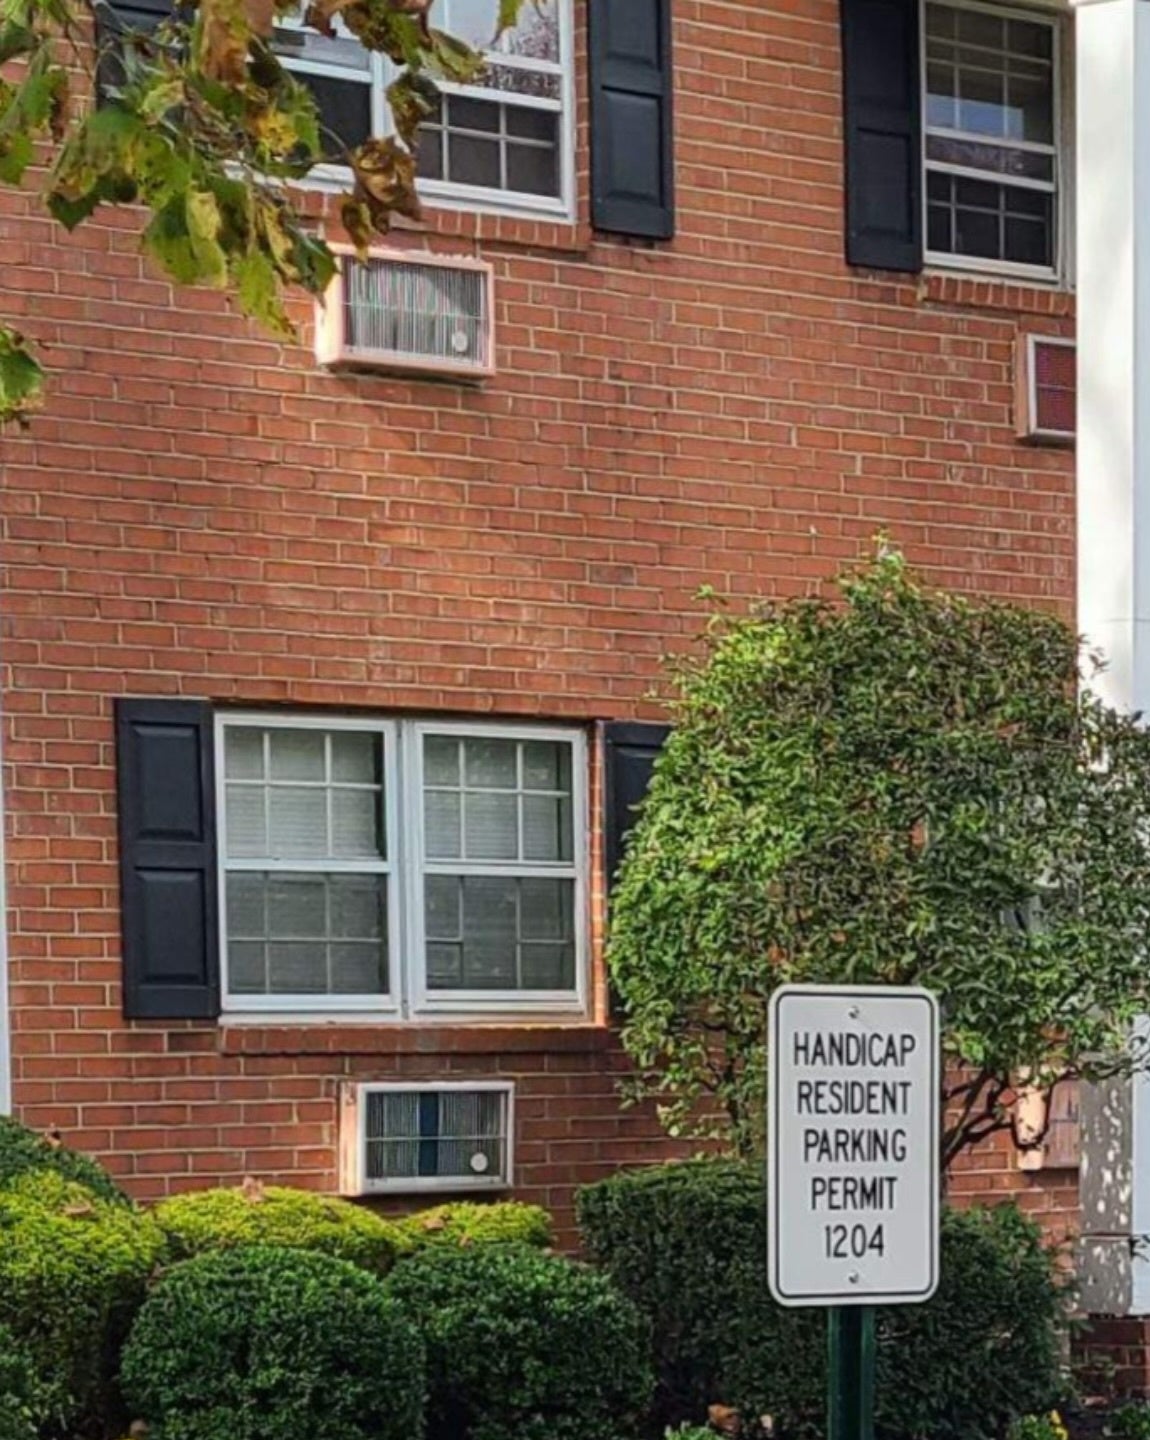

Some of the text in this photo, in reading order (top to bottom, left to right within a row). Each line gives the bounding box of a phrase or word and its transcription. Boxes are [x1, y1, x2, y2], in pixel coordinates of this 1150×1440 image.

[793, 1031, 917, 1067] HANDICAP
[796, 1079, 913, 1115] RESIDENT
[803, 1127, 908, 1163] PARKING
[810, 1175, 898, 1210] PERMIT
[825, 1223, 885, 1258] 1204
